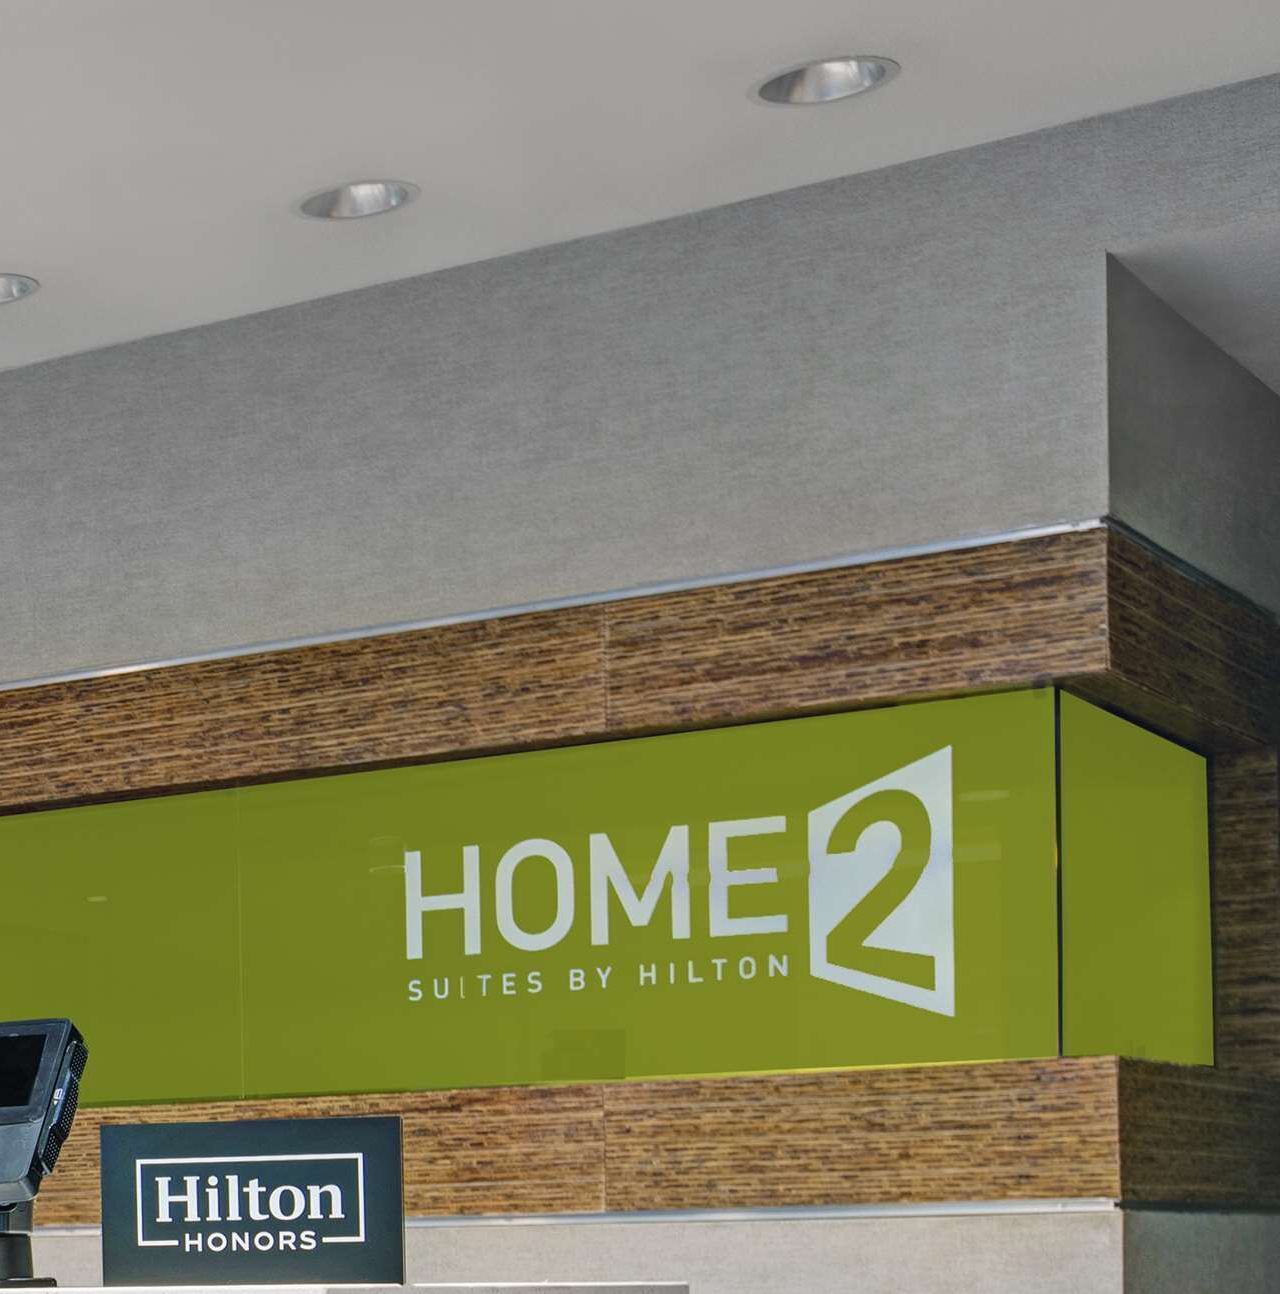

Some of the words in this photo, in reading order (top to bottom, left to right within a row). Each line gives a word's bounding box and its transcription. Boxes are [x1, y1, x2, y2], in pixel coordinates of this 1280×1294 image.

[407, 971, 544, 1002] SUITES
[568, 967, 614, 990] BY
[639, 955, 791, 987] HILTON
[154, 1174, 345, 1224] Hilton
[184, 1229, 318, 1253] HONORS
